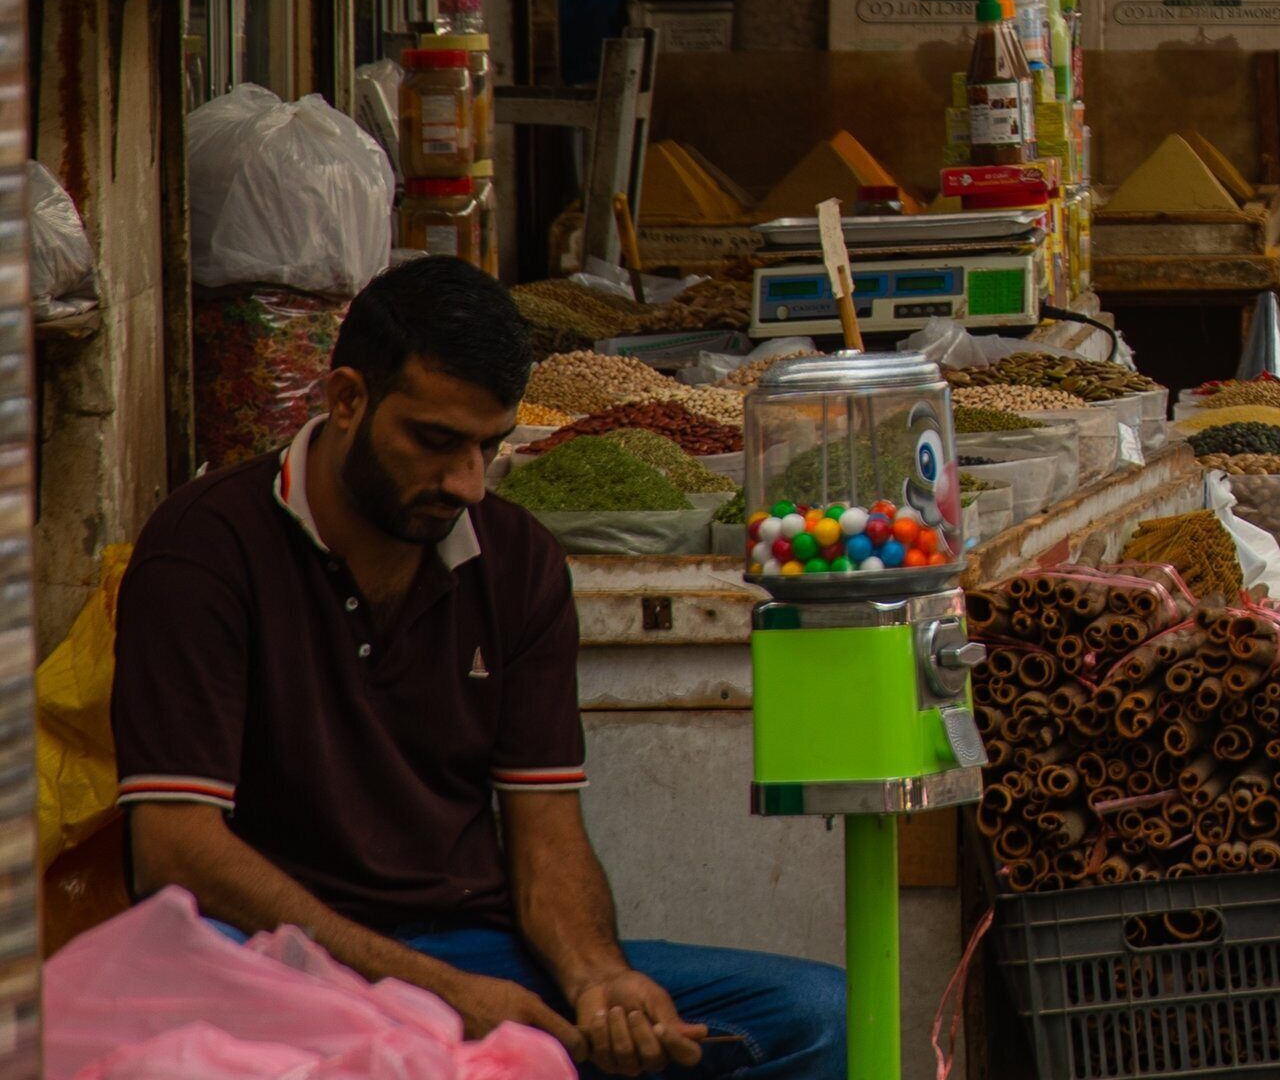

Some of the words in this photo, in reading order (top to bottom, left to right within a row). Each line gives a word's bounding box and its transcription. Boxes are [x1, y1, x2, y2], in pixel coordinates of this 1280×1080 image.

[896, 0, 931, 18] NUT
[934, 0, 973, 18] RECT
[1146, 6, 1175, 21] NUT
[1178, 6, 1226, 21] DIRECT
